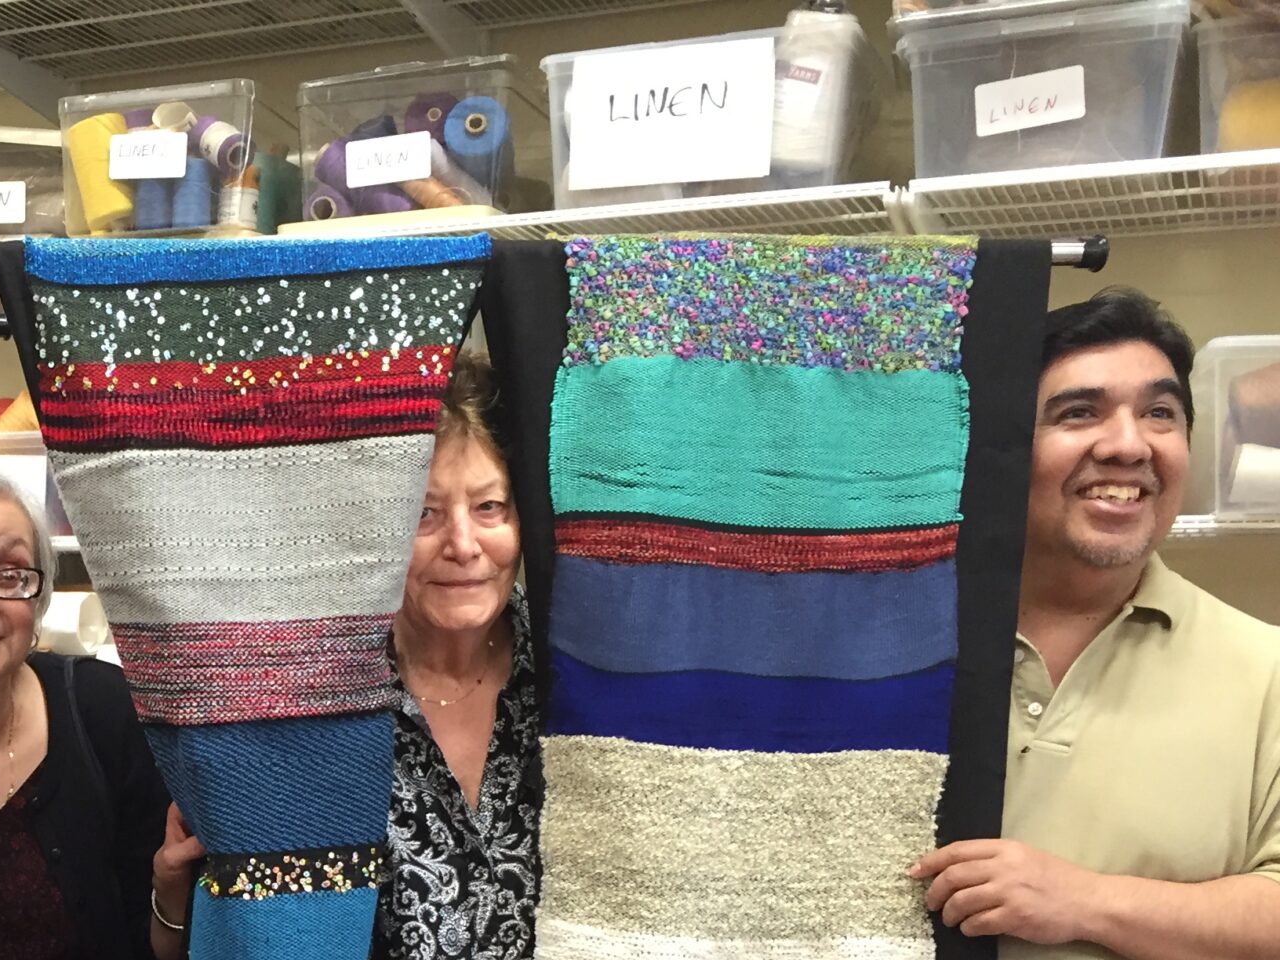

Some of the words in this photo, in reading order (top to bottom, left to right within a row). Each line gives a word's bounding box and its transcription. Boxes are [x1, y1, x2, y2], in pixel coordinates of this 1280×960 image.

[608, 80, 728, 122] LINEN
[989, 94, 1058, 124] LINEN
[118, 143, 165, 158] LINEN
[356, 149, 409, 171] LINEN
